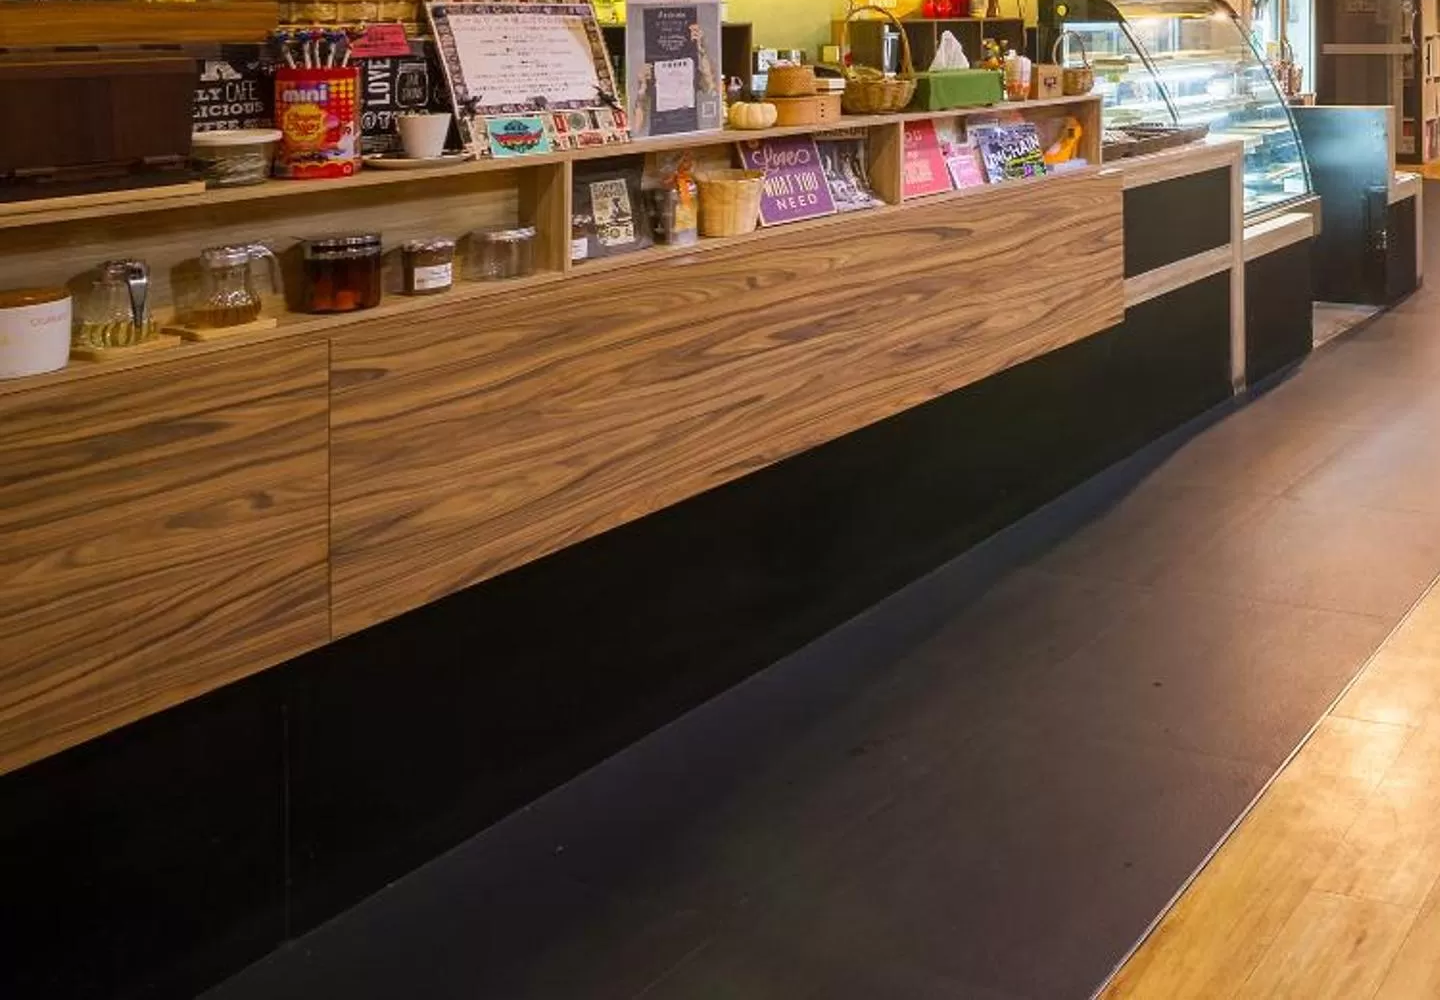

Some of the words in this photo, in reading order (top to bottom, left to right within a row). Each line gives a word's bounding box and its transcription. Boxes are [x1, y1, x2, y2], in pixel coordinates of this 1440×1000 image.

[367, 57, 392, 106] LOVE
[282, 84, 328, 103] mini
[776, 193, 819, 211] NEED
